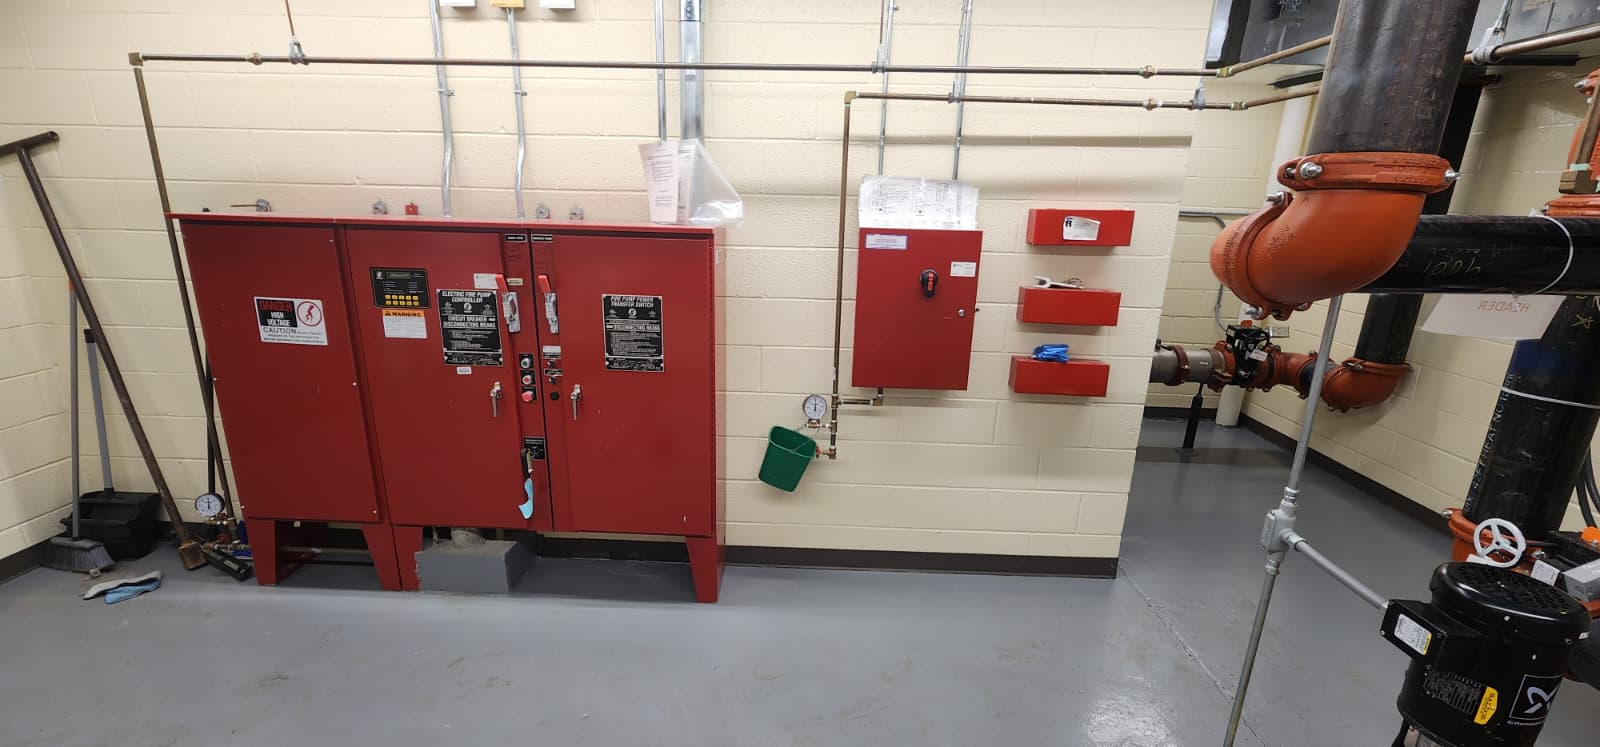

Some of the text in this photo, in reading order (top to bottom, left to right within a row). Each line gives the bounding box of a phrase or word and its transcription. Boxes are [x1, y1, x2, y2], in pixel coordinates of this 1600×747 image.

[260, 300, 292, 312] DANGER
[271, 311, 284, 319] HIGH
[266, 318, 291, 327] VOLTAGE
[263, 326, 297, 335] CAUTION
